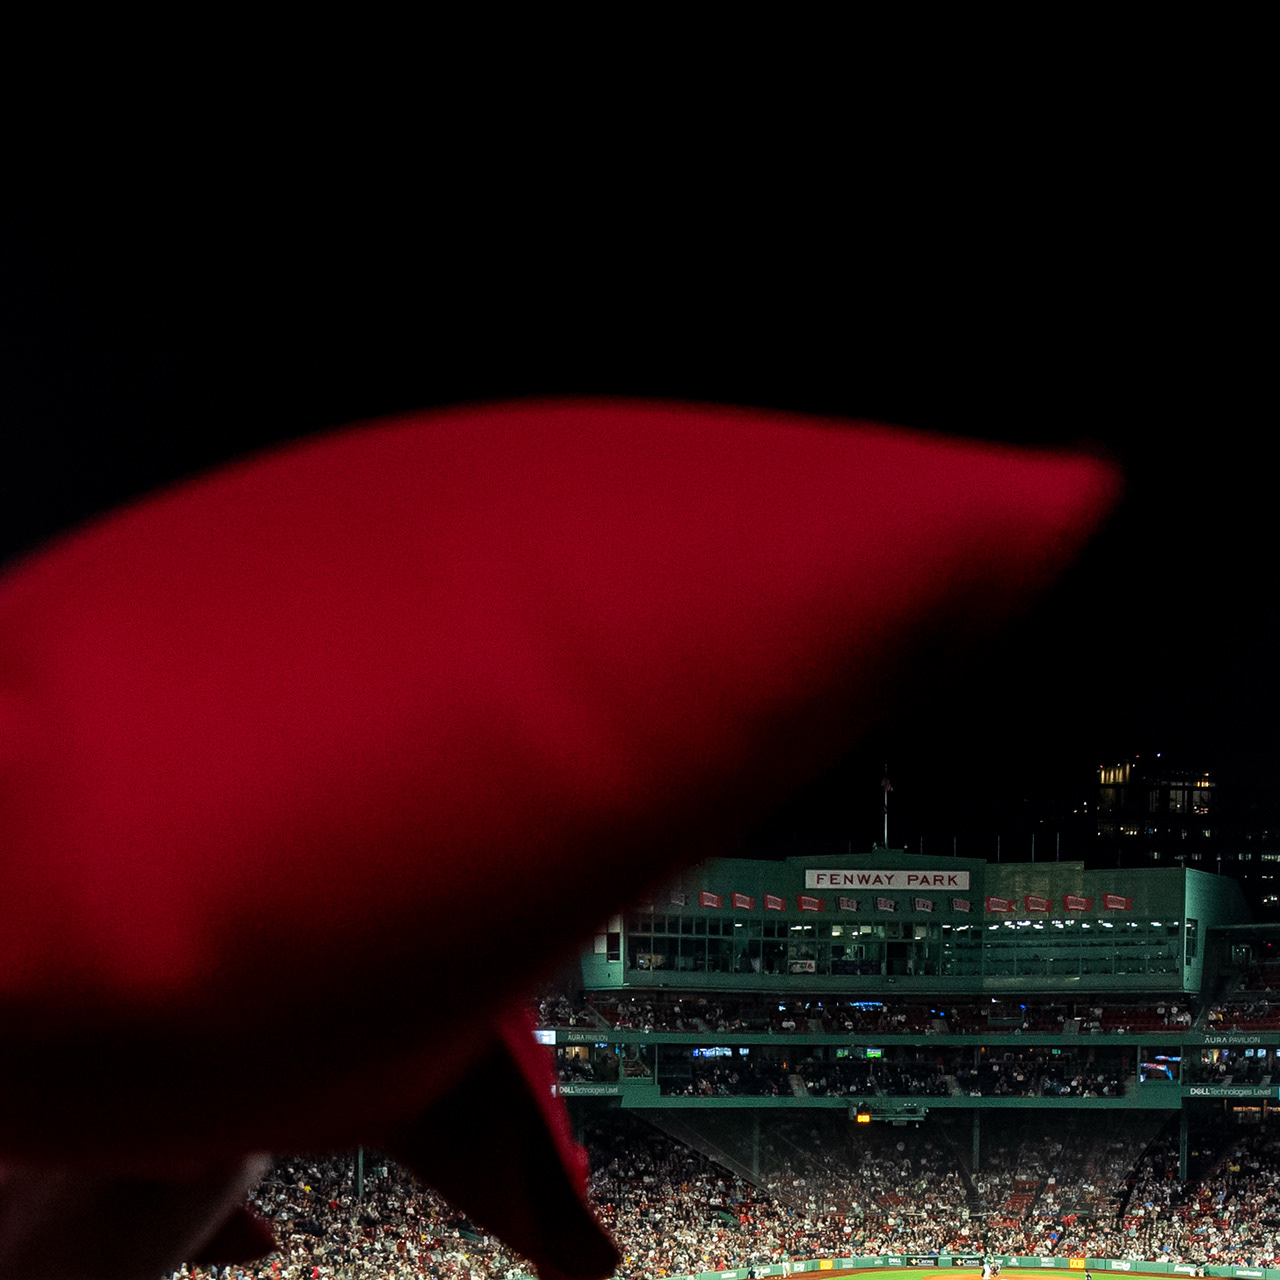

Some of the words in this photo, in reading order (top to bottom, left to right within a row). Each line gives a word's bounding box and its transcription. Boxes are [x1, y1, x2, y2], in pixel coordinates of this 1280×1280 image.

[816, 873, 895, 886] FENWAY
[907, 874, 959, 887] PARK
[559, 1086, 575, 1094] DELL
[1190, 1087, 1210, 1095] DELL
[1210, 1087, 1253, 1097] Technologies
[1253, 1088, 1272, 1096] Level
